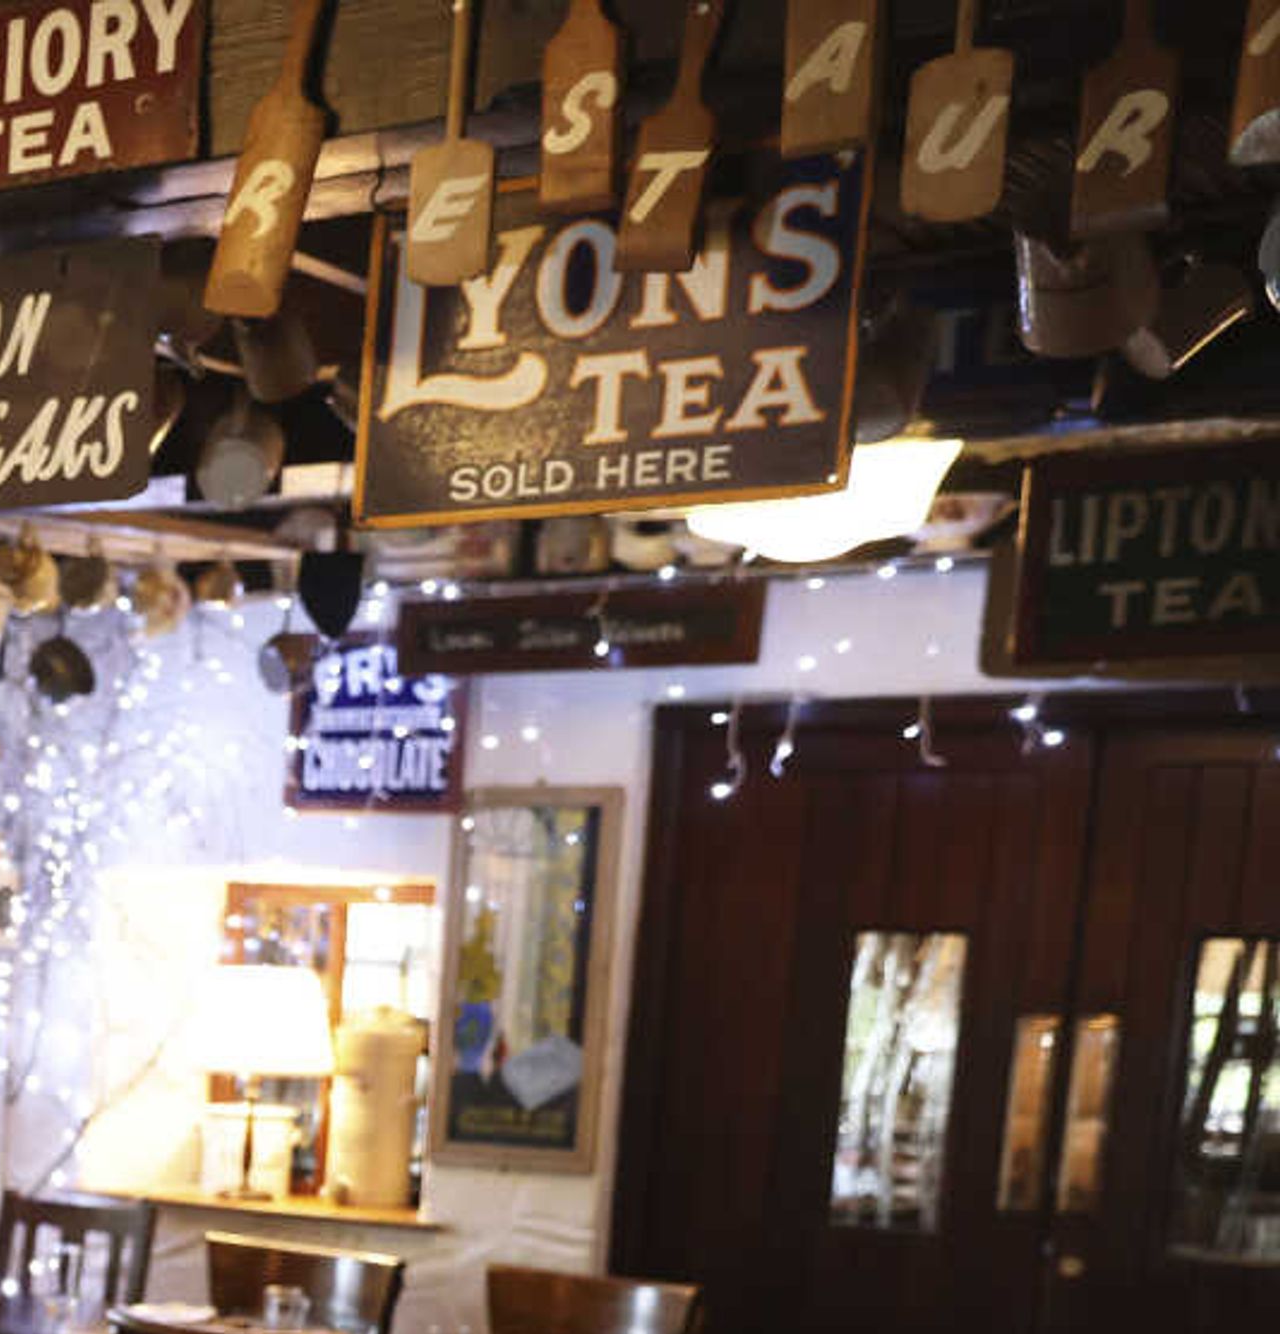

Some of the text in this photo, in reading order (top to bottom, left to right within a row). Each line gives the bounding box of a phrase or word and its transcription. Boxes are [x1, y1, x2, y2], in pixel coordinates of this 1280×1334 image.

[378, 180, 842, 422] LYONS
[569, 347, 825, 446] TEA
[448, 444, 732, 500] SOLD HERE
[1097, 573, 1263, 628] TEA
